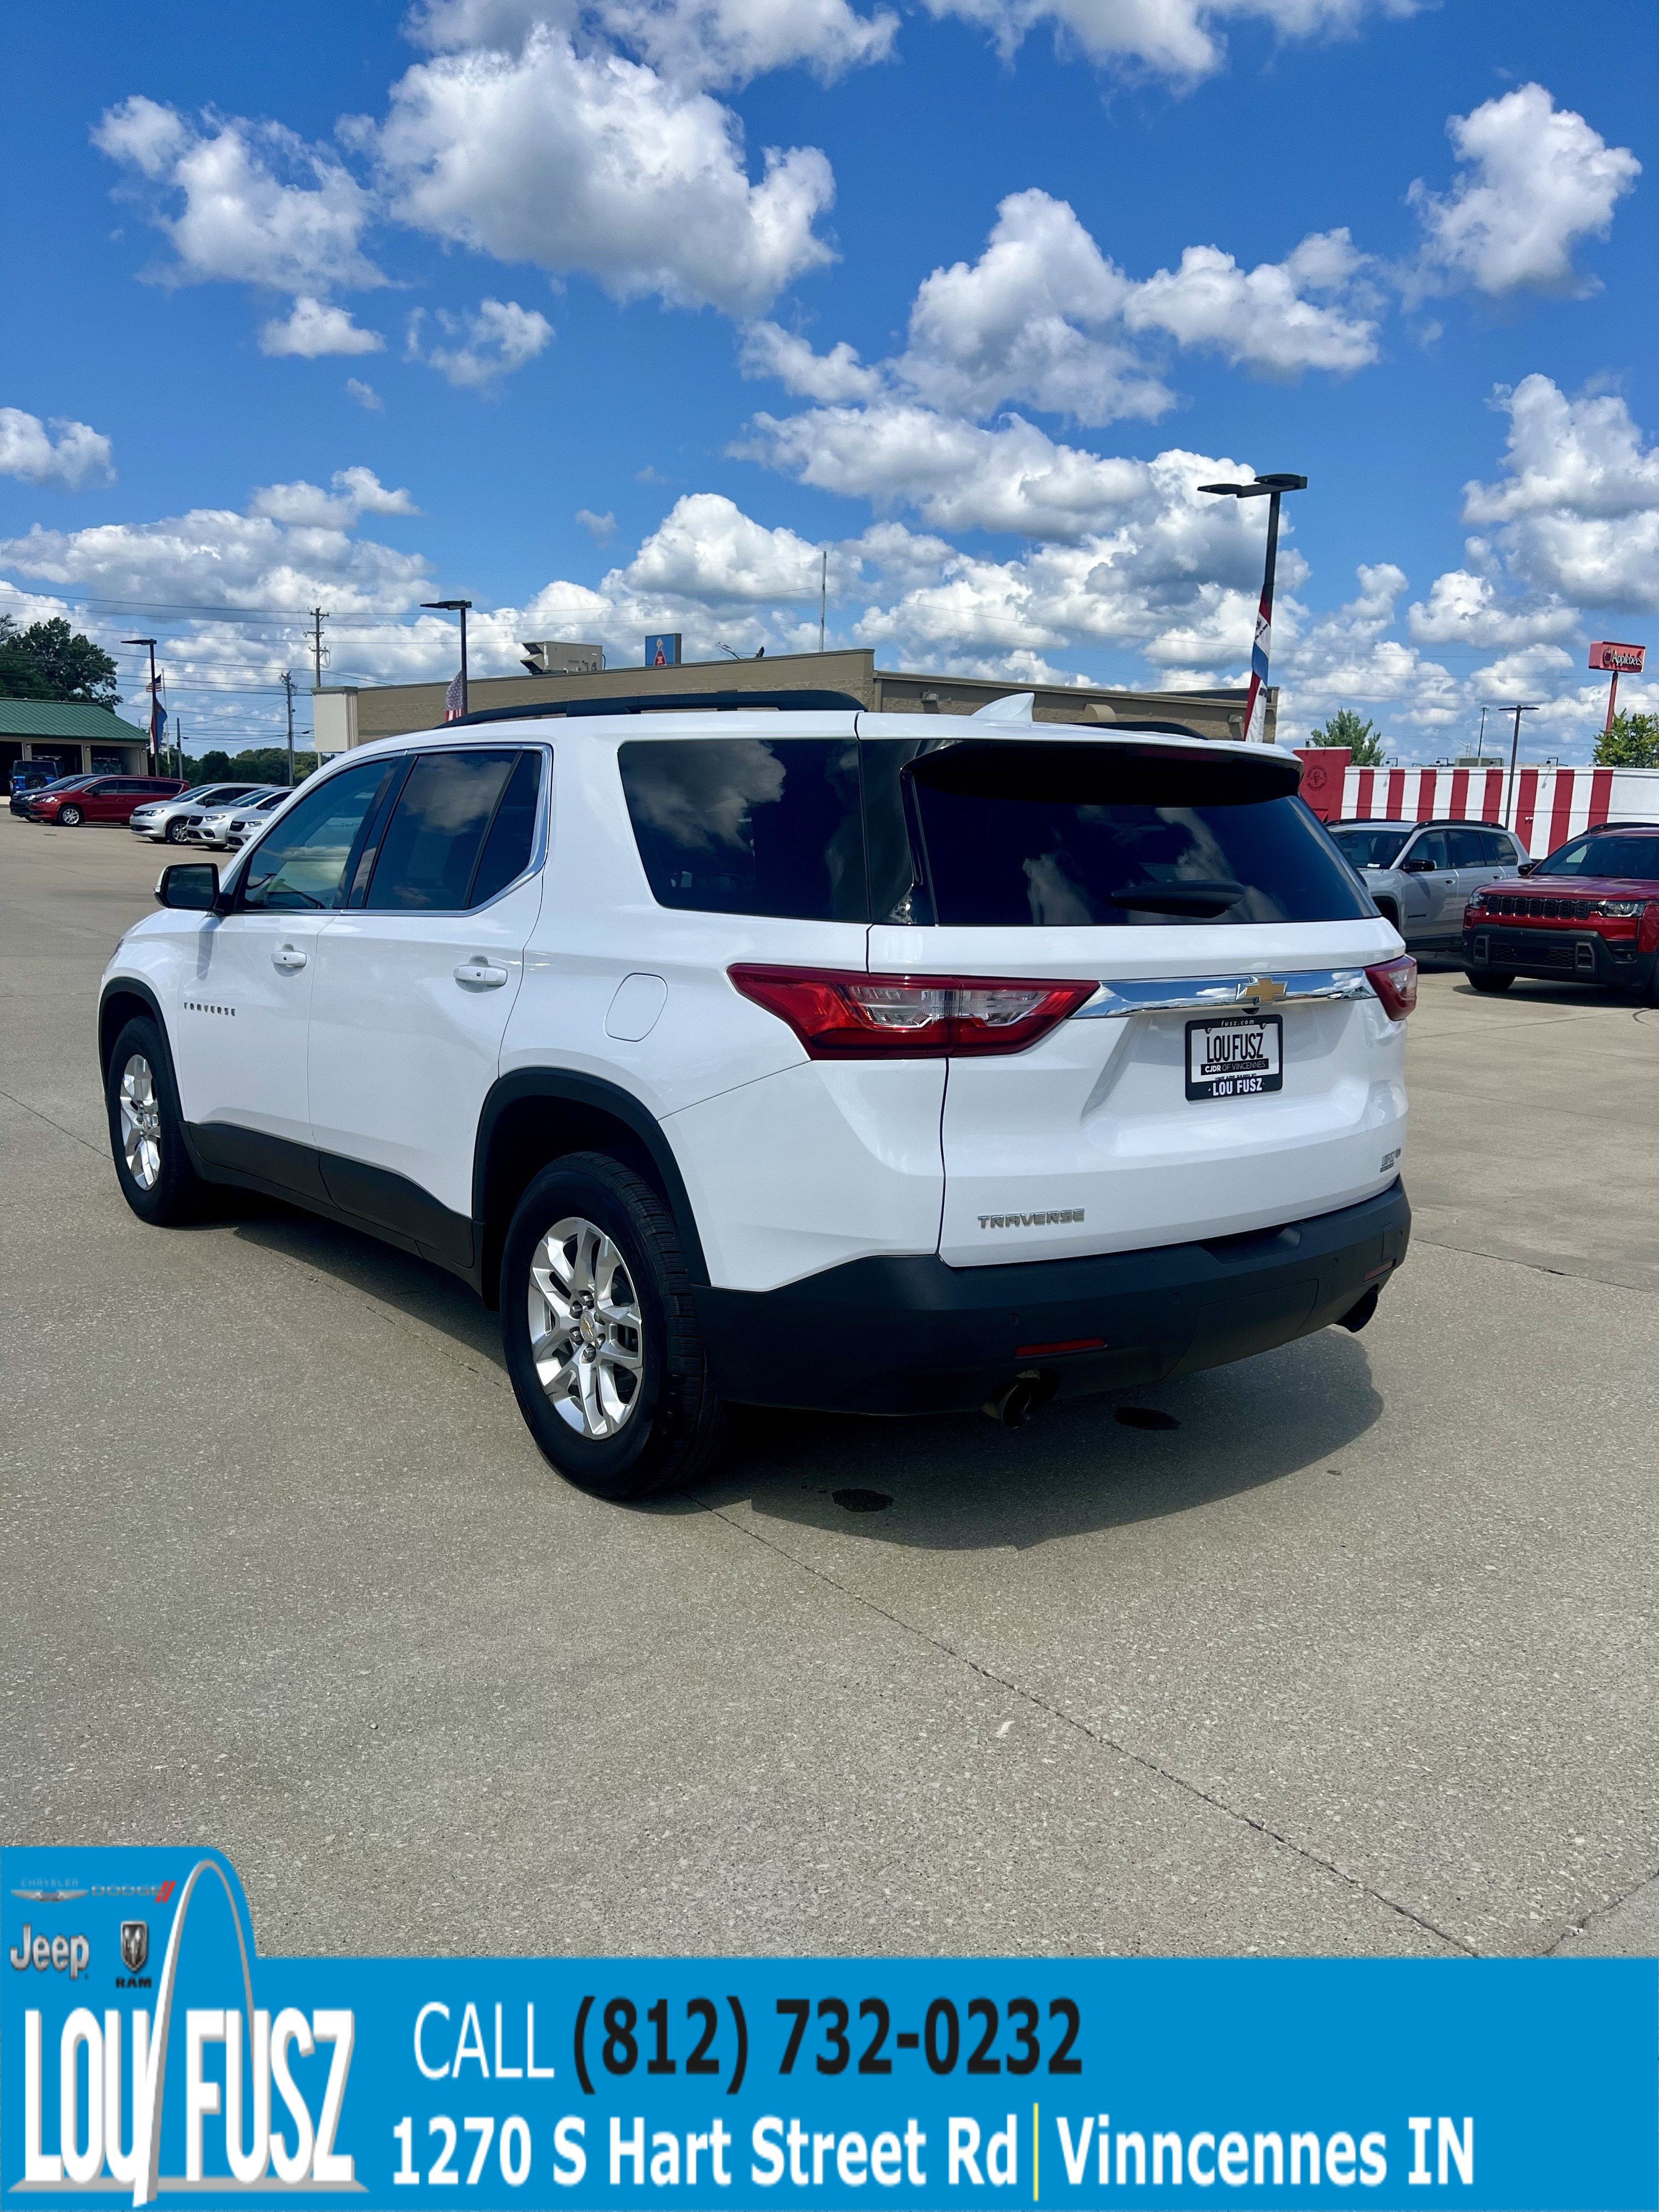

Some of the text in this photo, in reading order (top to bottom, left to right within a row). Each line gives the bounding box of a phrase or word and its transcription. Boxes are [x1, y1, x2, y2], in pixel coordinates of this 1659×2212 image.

[183, 1002, 236, 1017] TRAVERSE
[1207, 1032, 1263, 1063] LOU FUSZ
[1205, 1060, 1266, 1073] CJDR OF VINCENNES
[1212, 1077, 1262, 1096] LOU FUSZ
[977, 1208, 1085, 1230] TRAVERSE
